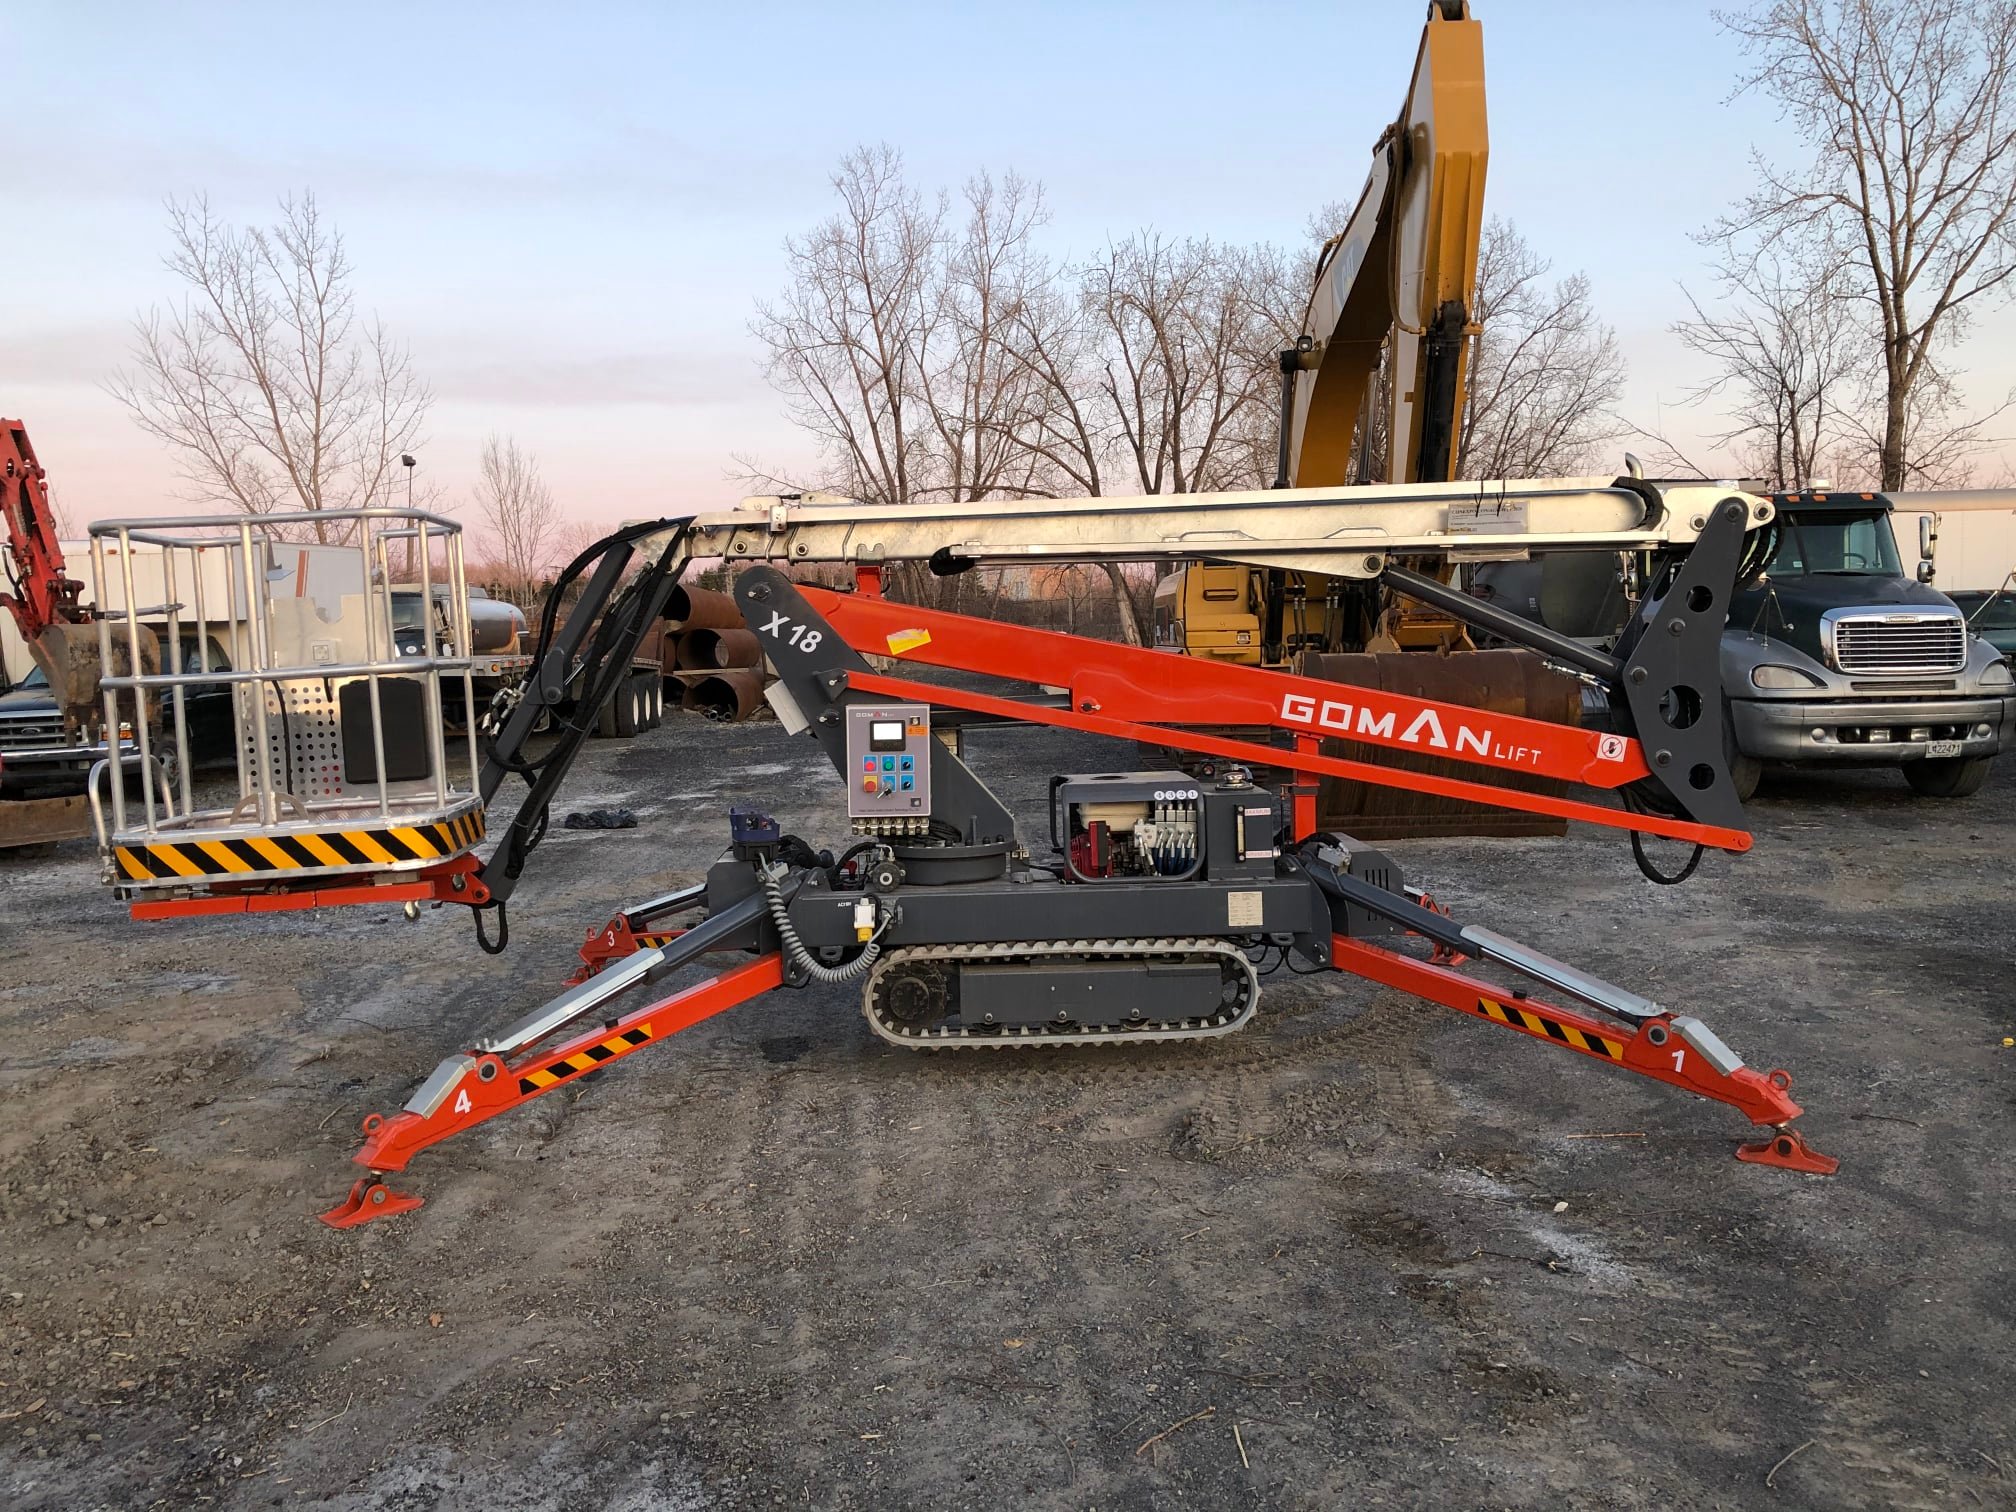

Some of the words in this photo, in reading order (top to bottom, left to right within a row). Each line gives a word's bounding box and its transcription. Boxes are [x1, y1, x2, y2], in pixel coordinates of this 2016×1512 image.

[758, 610, 791, 639] X
[788, 624, 823, 653] 18
[1280, 693, 1492, 756] GOMAN
[1494, 742, 1542, 765] LIFT
[607, 930, 615, 947] 3
[1671, 1049, 1686, 1073] 1
[454, 1088, 472, 1114] 4
